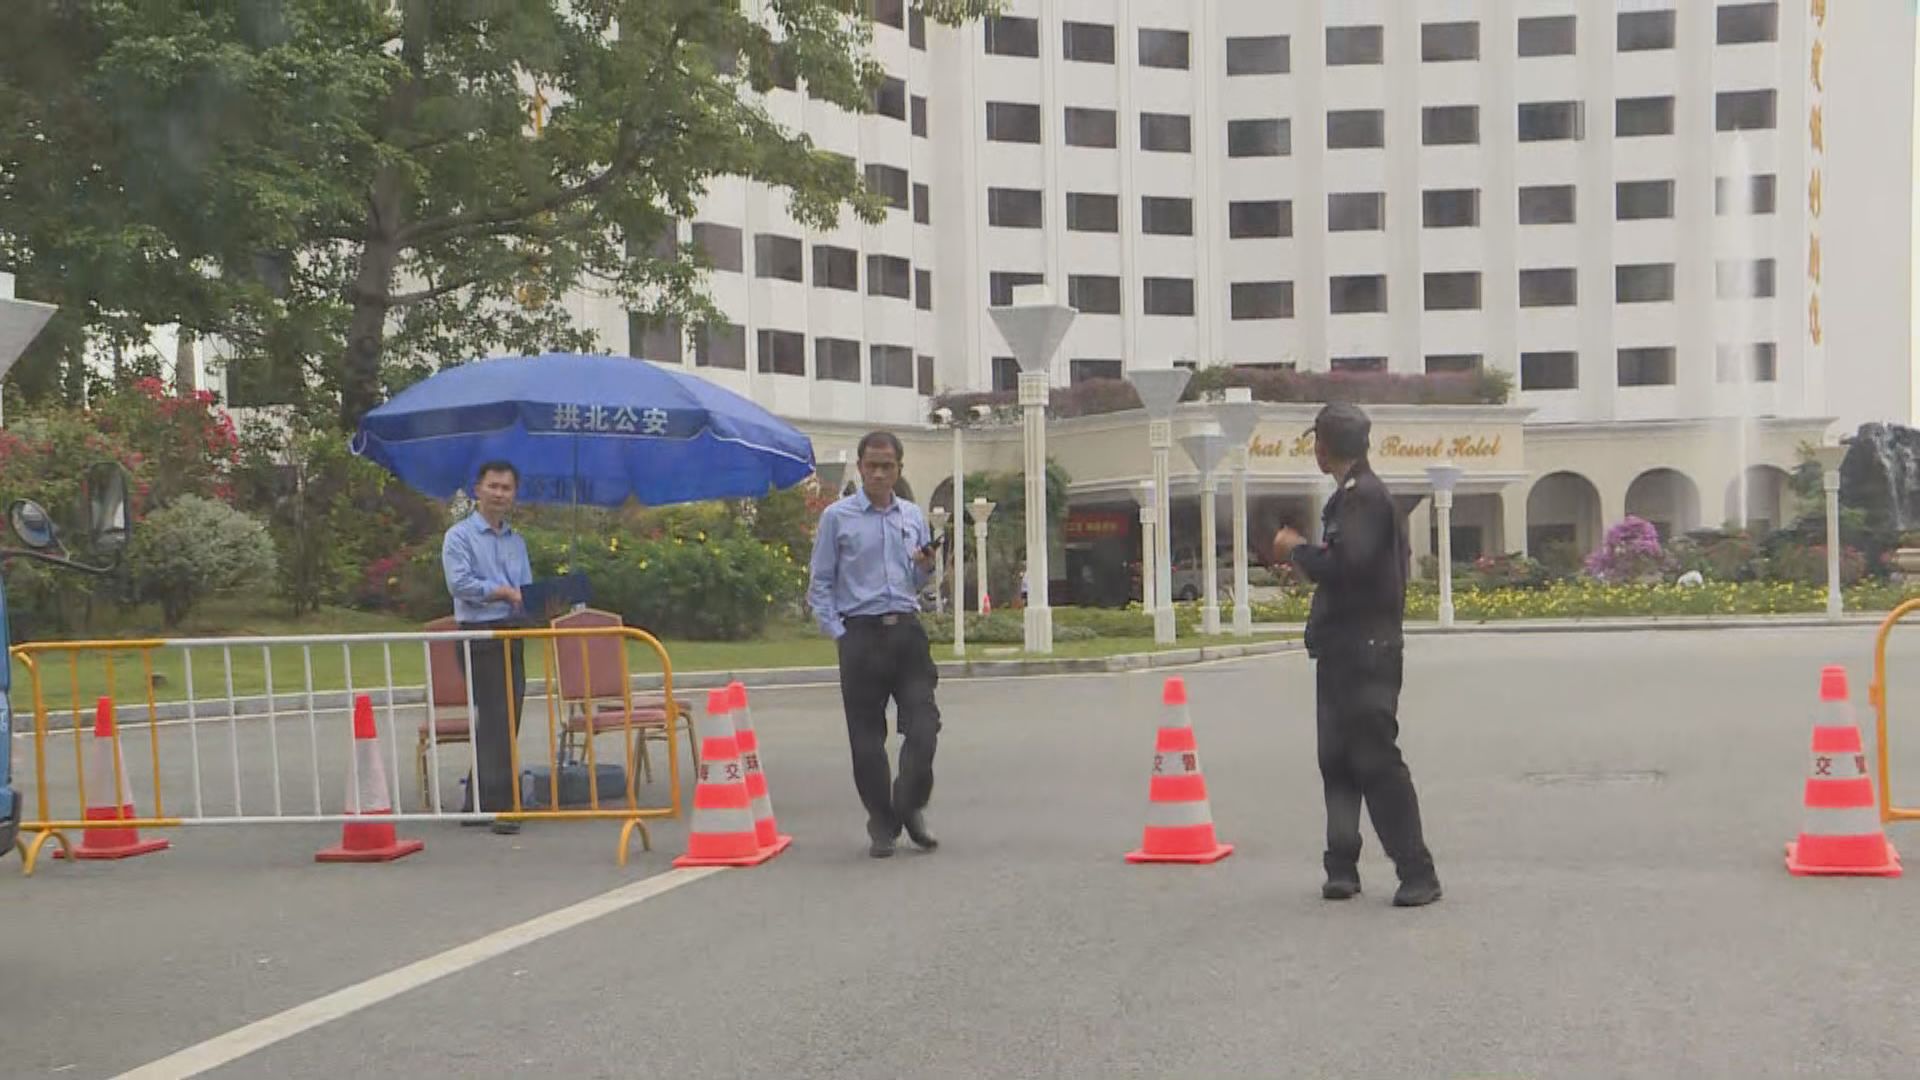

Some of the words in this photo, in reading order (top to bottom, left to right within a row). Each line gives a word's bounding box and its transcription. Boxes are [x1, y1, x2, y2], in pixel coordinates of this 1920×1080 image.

[553, 403, 668, 434] 拱北公安
[1380, 435, 1443, 457] Resort
[1447, 433, 1500, 457] Hotel
